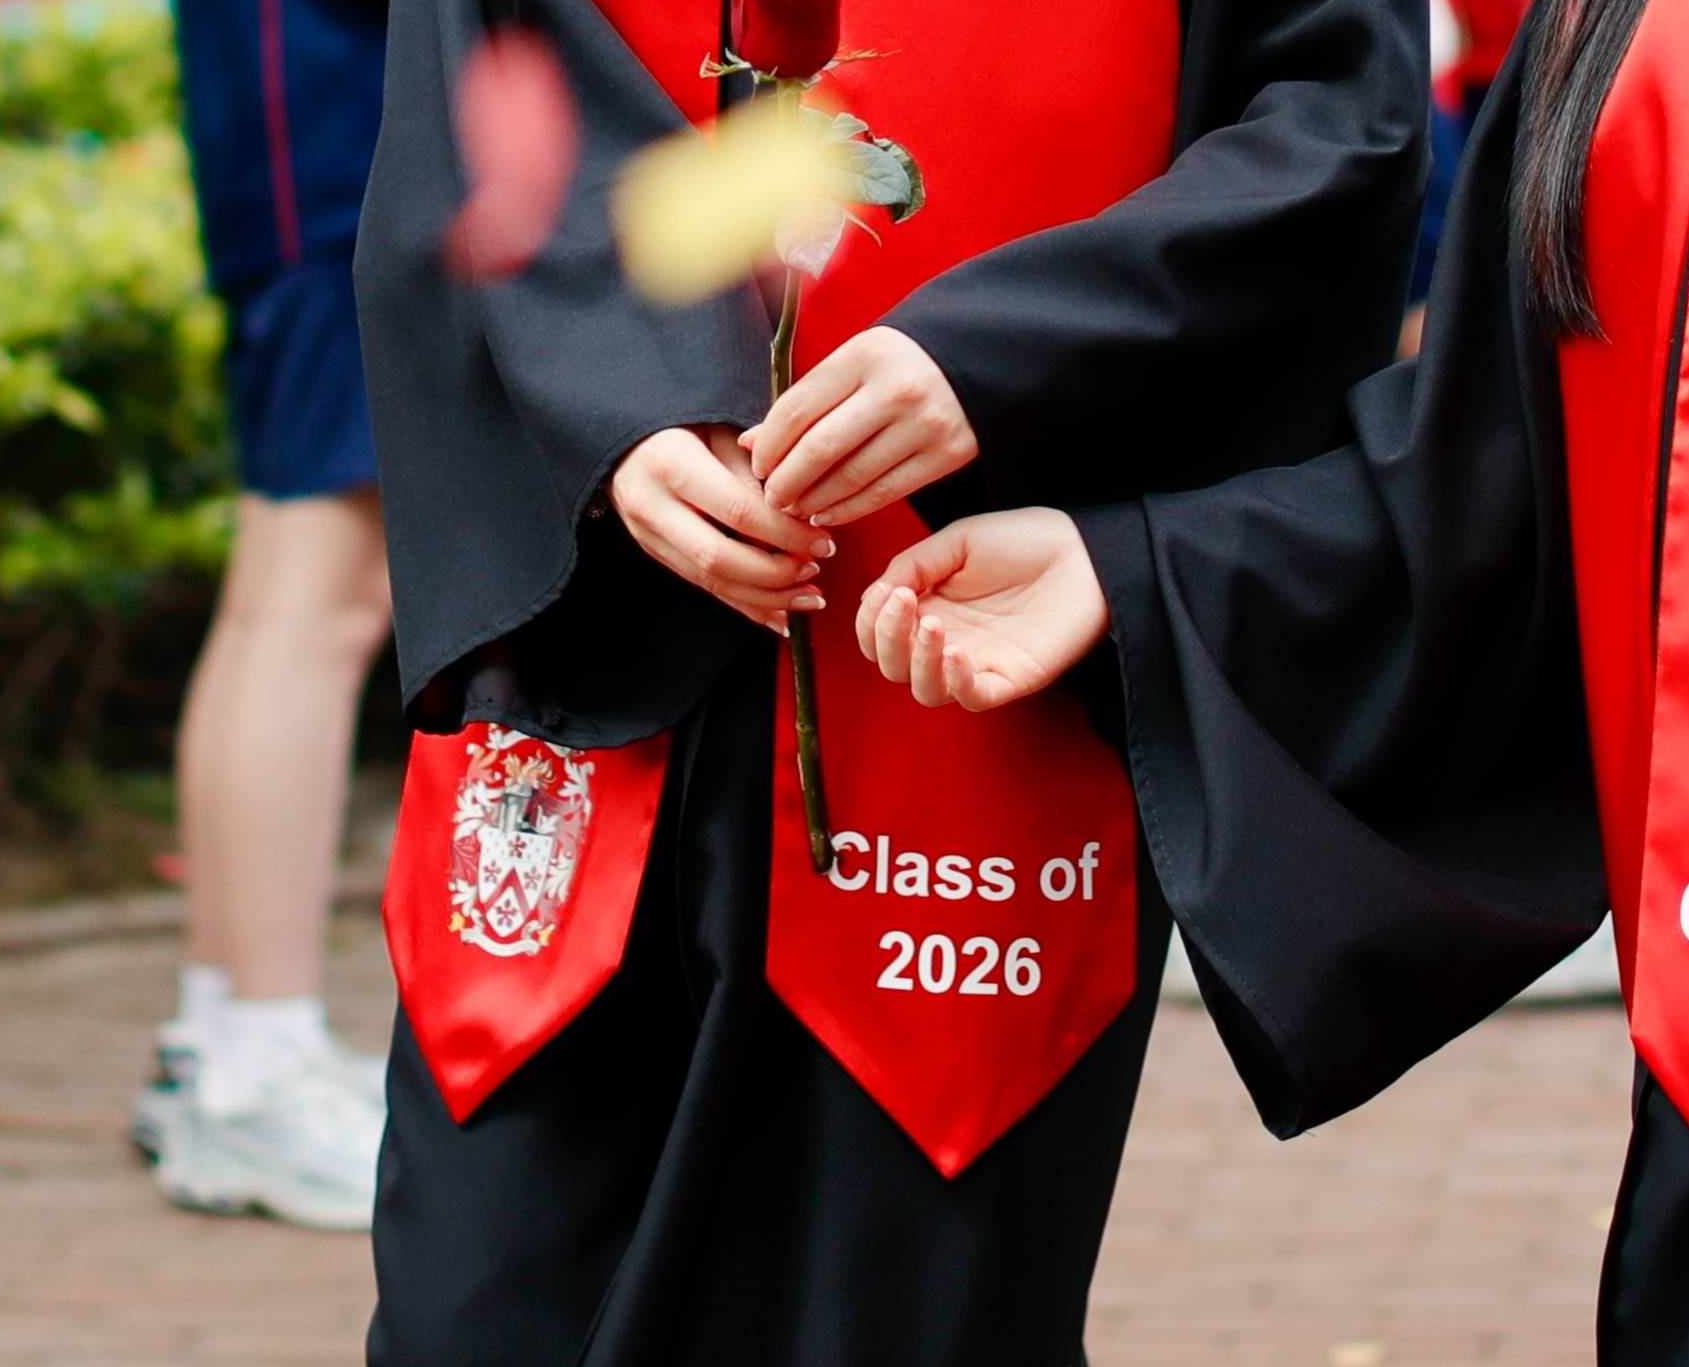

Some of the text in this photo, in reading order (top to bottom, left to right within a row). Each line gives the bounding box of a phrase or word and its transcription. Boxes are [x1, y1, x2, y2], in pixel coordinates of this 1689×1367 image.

[828, 831, 1101, 902] Class of
[876, 930, 1042, 996] 2026
